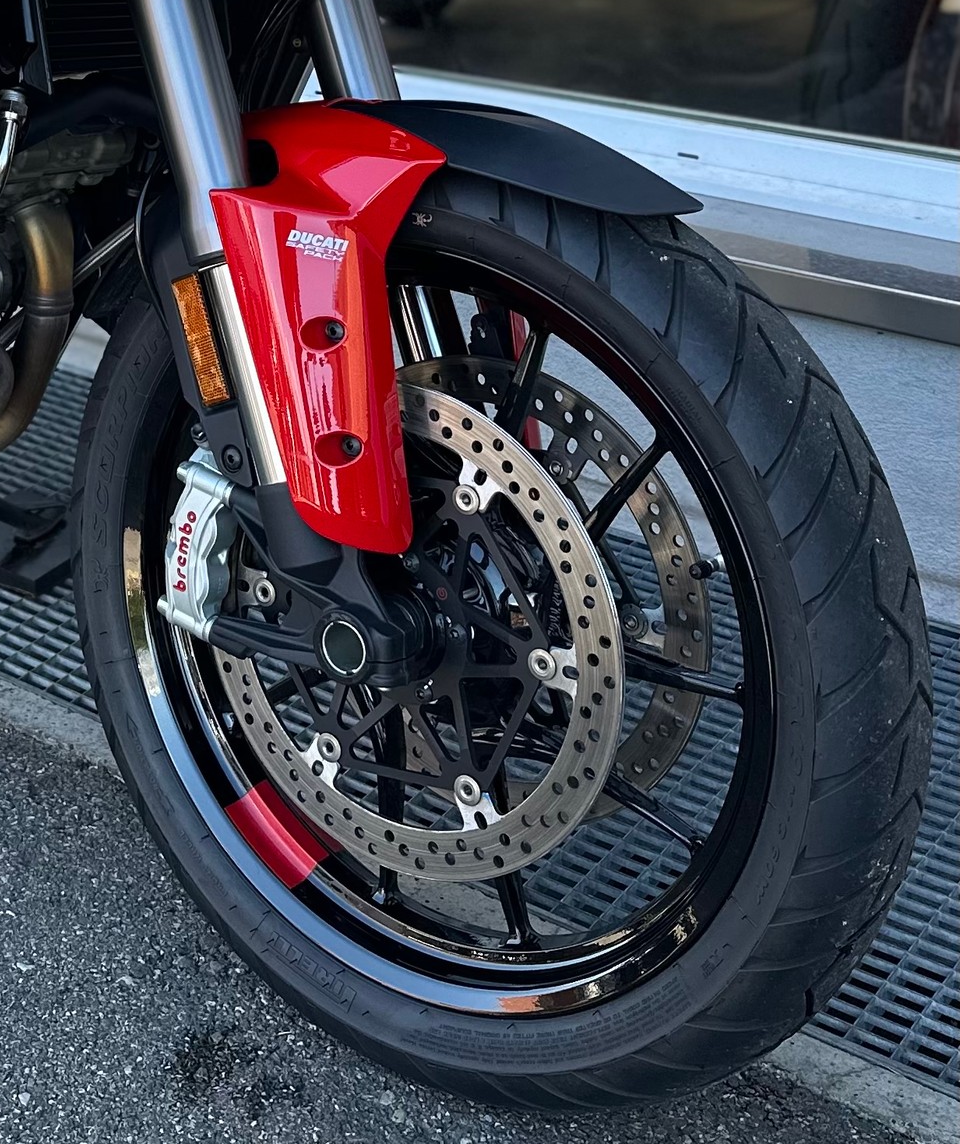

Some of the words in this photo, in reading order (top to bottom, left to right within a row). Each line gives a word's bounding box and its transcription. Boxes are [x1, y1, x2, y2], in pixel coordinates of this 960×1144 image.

[285, 240, 346, 256] SAFETY
[287, 229, 350, 252] DUCATI
[303, 250, 344, 263] PACK
[172, 510, 197, 593] brembo
[267, 931, 357, 1014] PIRELLI
